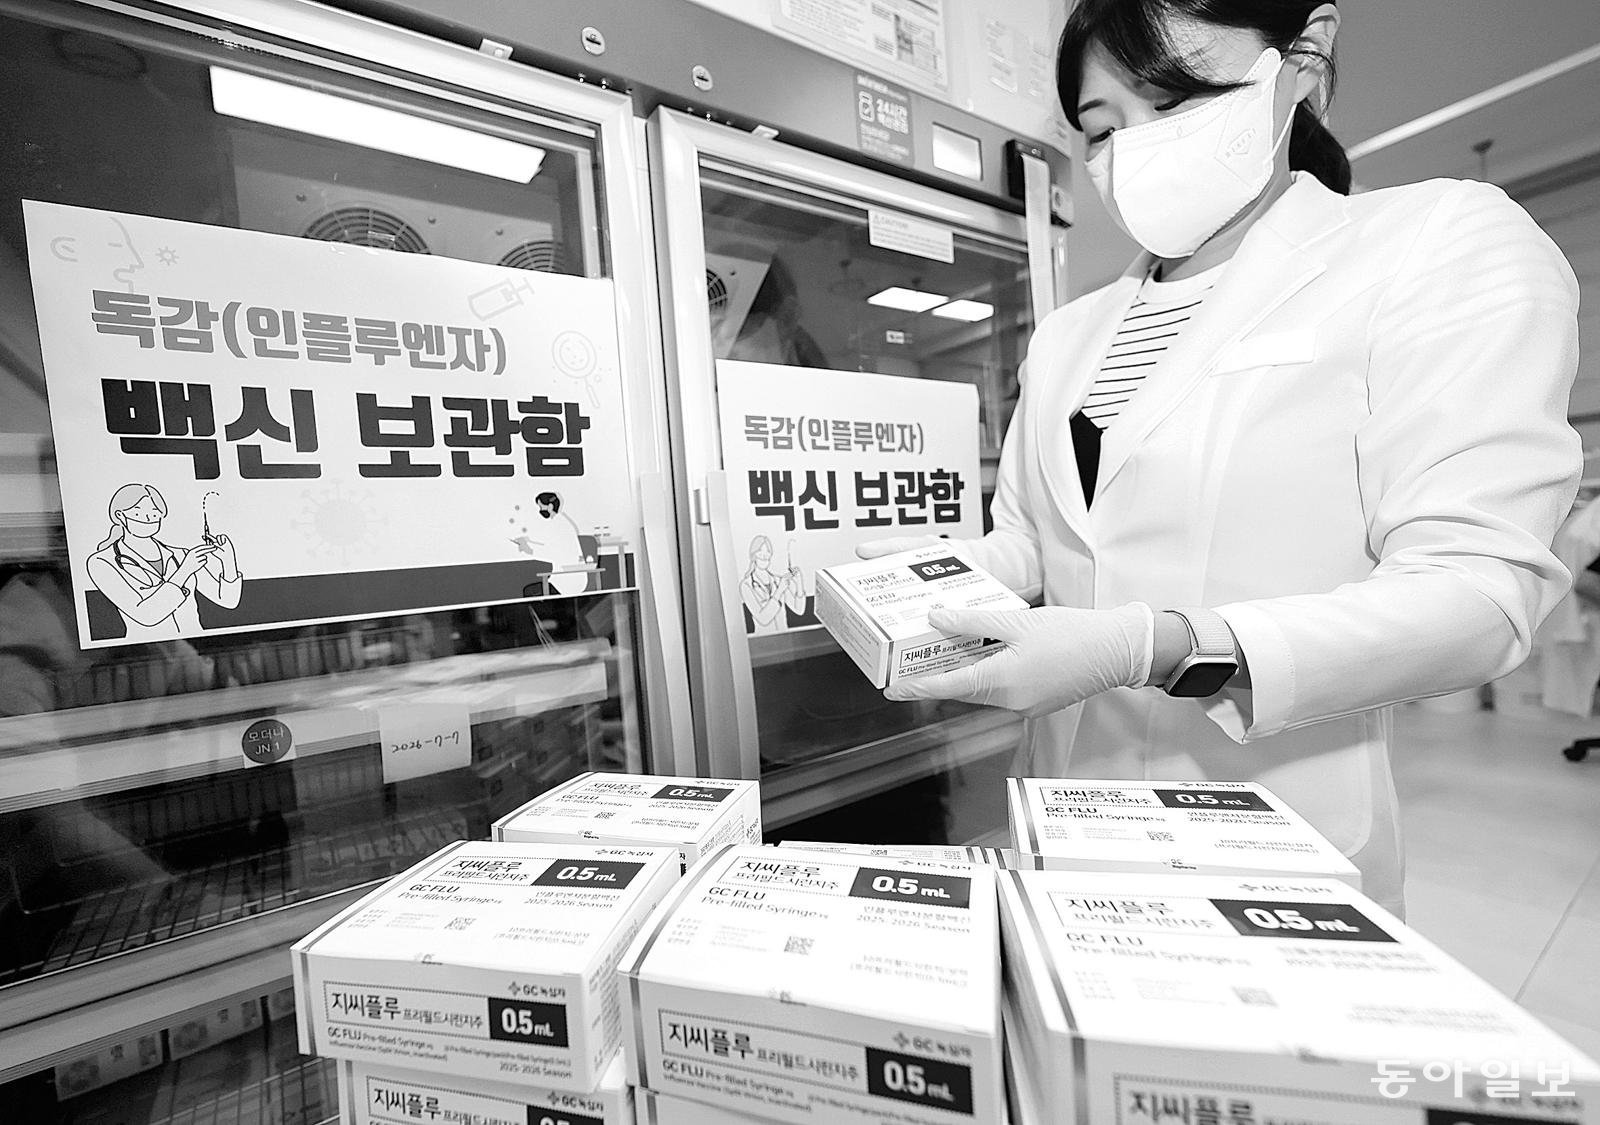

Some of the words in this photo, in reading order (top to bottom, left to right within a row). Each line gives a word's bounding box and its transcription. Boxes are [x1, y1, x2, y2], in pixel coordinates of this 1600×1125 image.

[91, 289, 507, 375] 독감(인플루엔자)
[101, 378, 322, 480] 백신
[355, 393, 591, 478] 보관함
[744, 414, 924, 454] 독감(인플루엔자)
[747, 470, 840, 531] 백신
[854, 468, 965, 527] 보관함
[904, 644, 942, 662] 지씨플루
[248, 726, 284, 743] 모더나
[1050, 790, 1127, 799] 지씨플루
[451, 860, 523, 872] 지씨플루
[740, 861, 821, 878] 지씨플루
[409, 883, 431, 892] GC
[429, 885, 461, 894] FLU
[708, 886, 732, 897] GC
[733, 889, 766, 901] FLU
[397, 892, 453, 901] Pre-filled
[451, 895, 494, 905] Syringe
[523, 898, 576, 906] 2025-2026
[576, 900, 614, 909] Season
[701, 896, 763, 911] Pre-filled
[765, 904, 818, 918] Syringe
[1064, 898, 1174, 915] 지씨플루
[1066, 932, 1095, 944] GC
[1100, 935, 1144, 946] FLU
[522, 985, 539, 997] GC
[331, 992, 401, 1020] 지씨플루
[403, 1008, 484, 1030] 프리필드시린지주
[327, 1026, 343, 1039] GC
[342, 1028, 362, 1042] FLU
[668, 1022, 753, 1059] 지씨플루
[662, 1058, 679, 1073] GC
[680, 1063, 705, 1078] FLU
[374, 1088, 442, 1120] 지씨플루
[561, 1095, 579, 1107] GC
